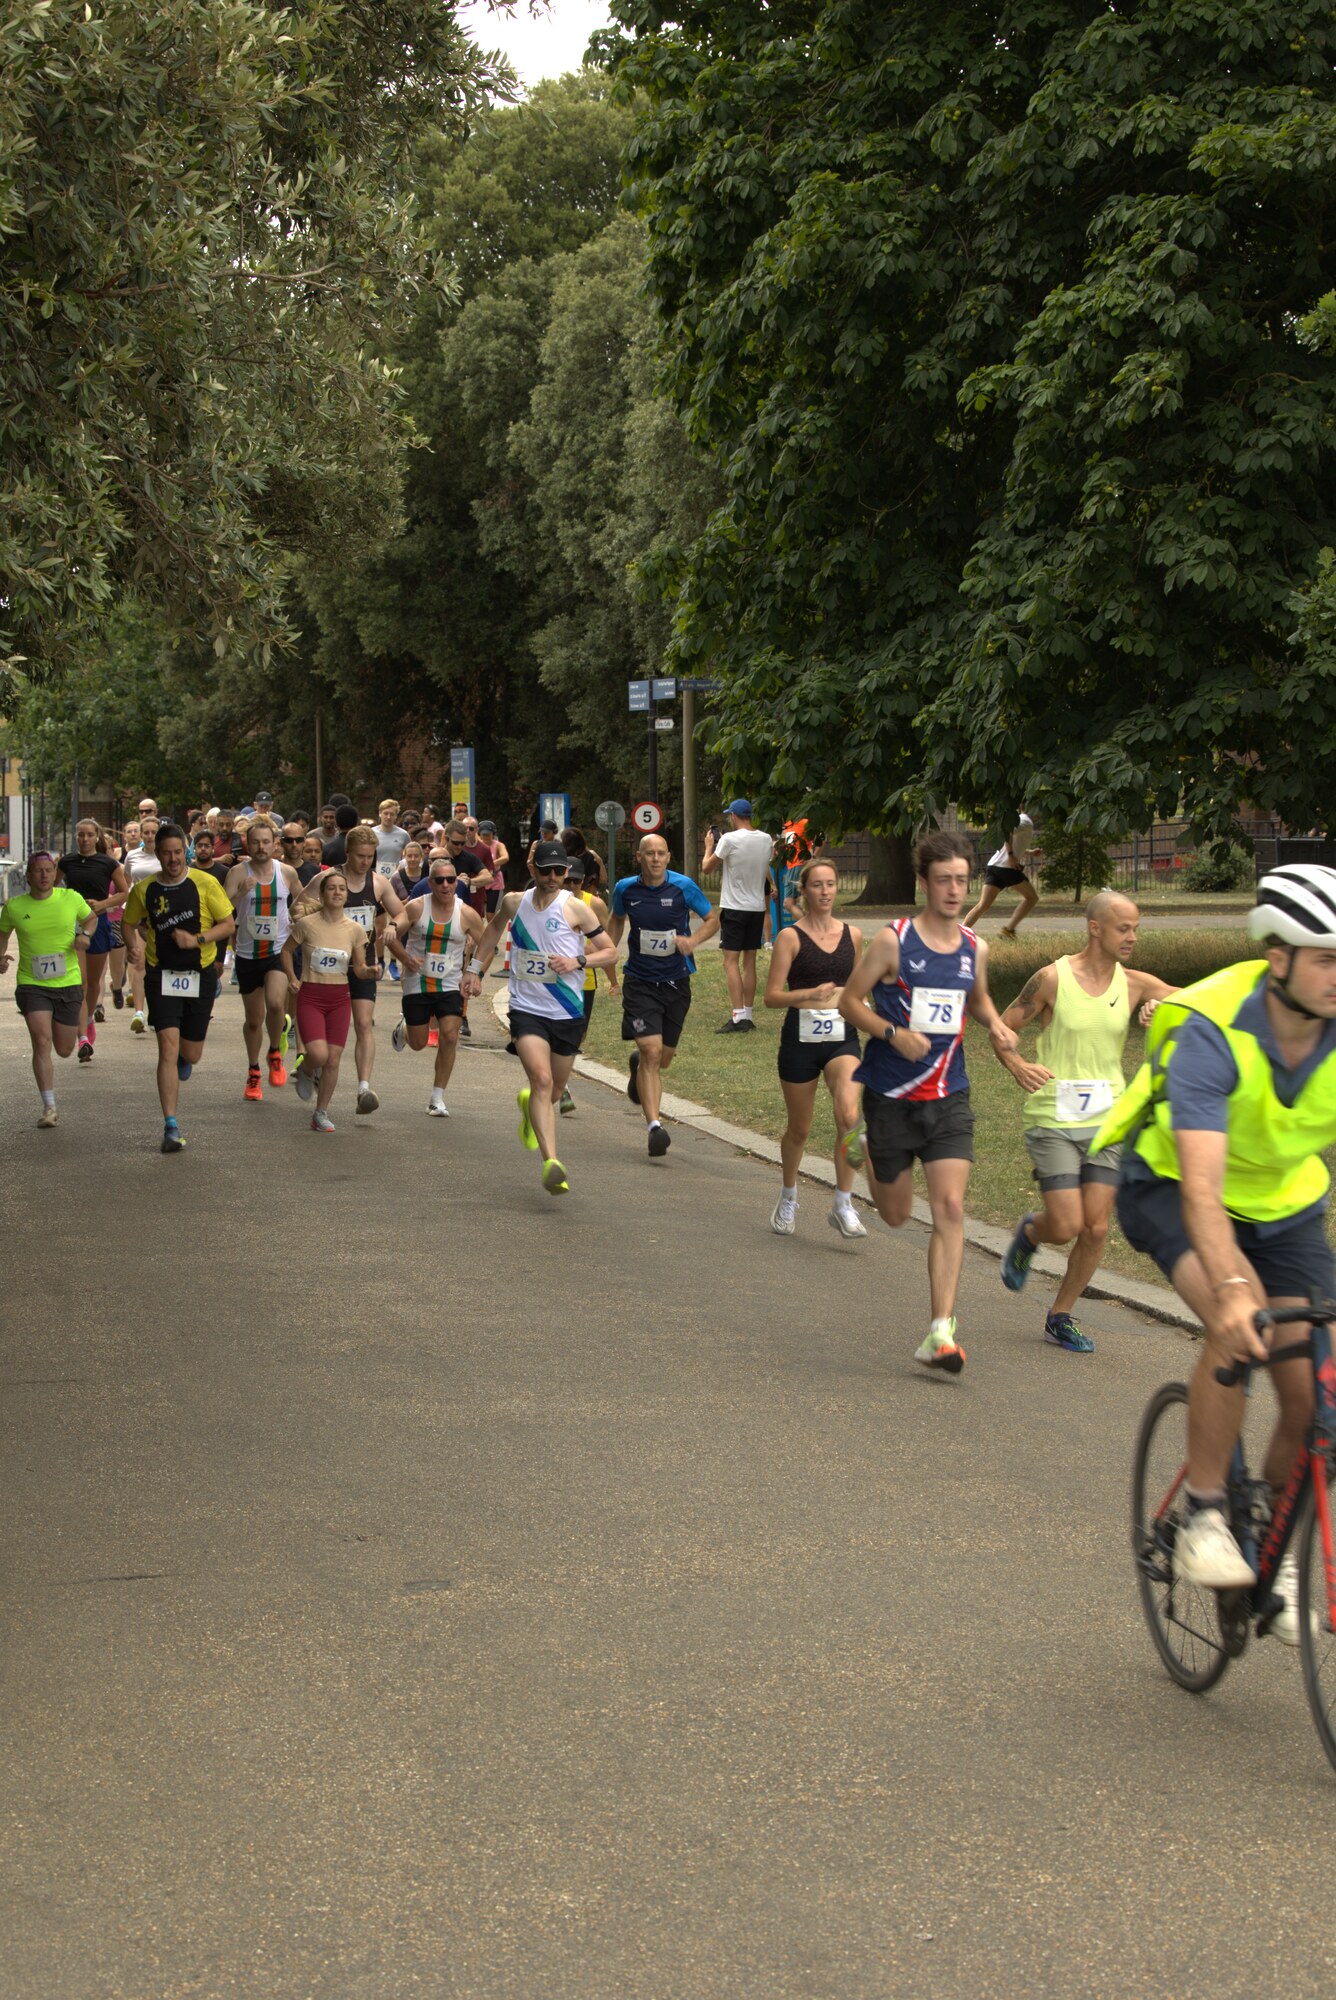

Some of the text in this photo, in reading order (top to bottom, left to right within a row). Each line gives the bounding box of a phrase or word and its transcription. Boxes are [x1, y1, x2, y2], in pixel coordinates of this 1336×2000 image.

[643, 811, 652, 823] 5
[380, 866, 391, 875] 50
[352, 914, 367, 926] 11
[255, 923, 271, 935] 75
[649, 938, 668, 951] 74
[40, 960, 57, 974] 71
[320, 956, 337, 967] 49
[430, 961, 445, 973] 16
[526, 960, 546, 976] 23
[171, 977, 190, 990] 40
[928, 1002, 954, 1024] 78
[812, 1020, 834, 1035] 29
[1078, 1093, 1092, 1111] 7
